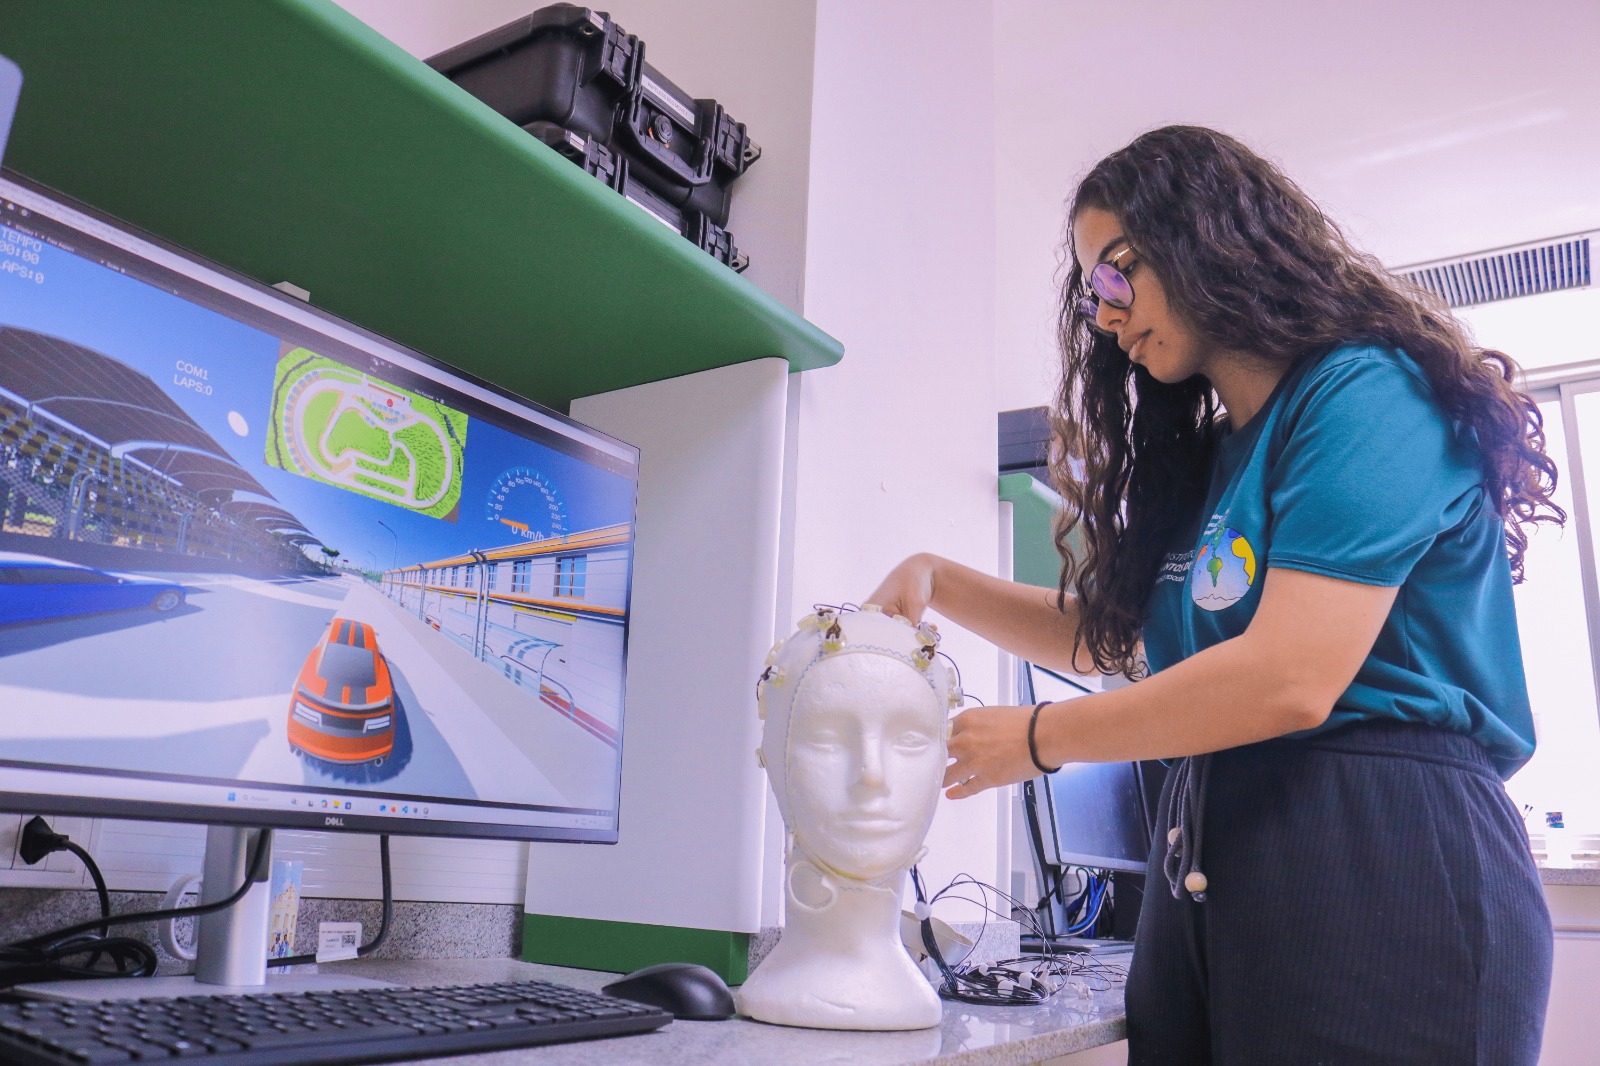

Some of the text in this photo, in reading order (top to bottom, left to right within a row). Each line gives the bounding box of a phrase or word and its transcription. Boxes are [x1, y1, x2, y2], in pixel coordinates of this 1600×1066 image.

[1, 226, 42, 252] TEMPO
[0, 260, 44, 284] APS:0
[176, 360, 208, 380] COM1
[174, 374, 212, 396] LAPS:0
[521, 529, 544, 542] km/h
[325, 816, 344, 826] DELL
